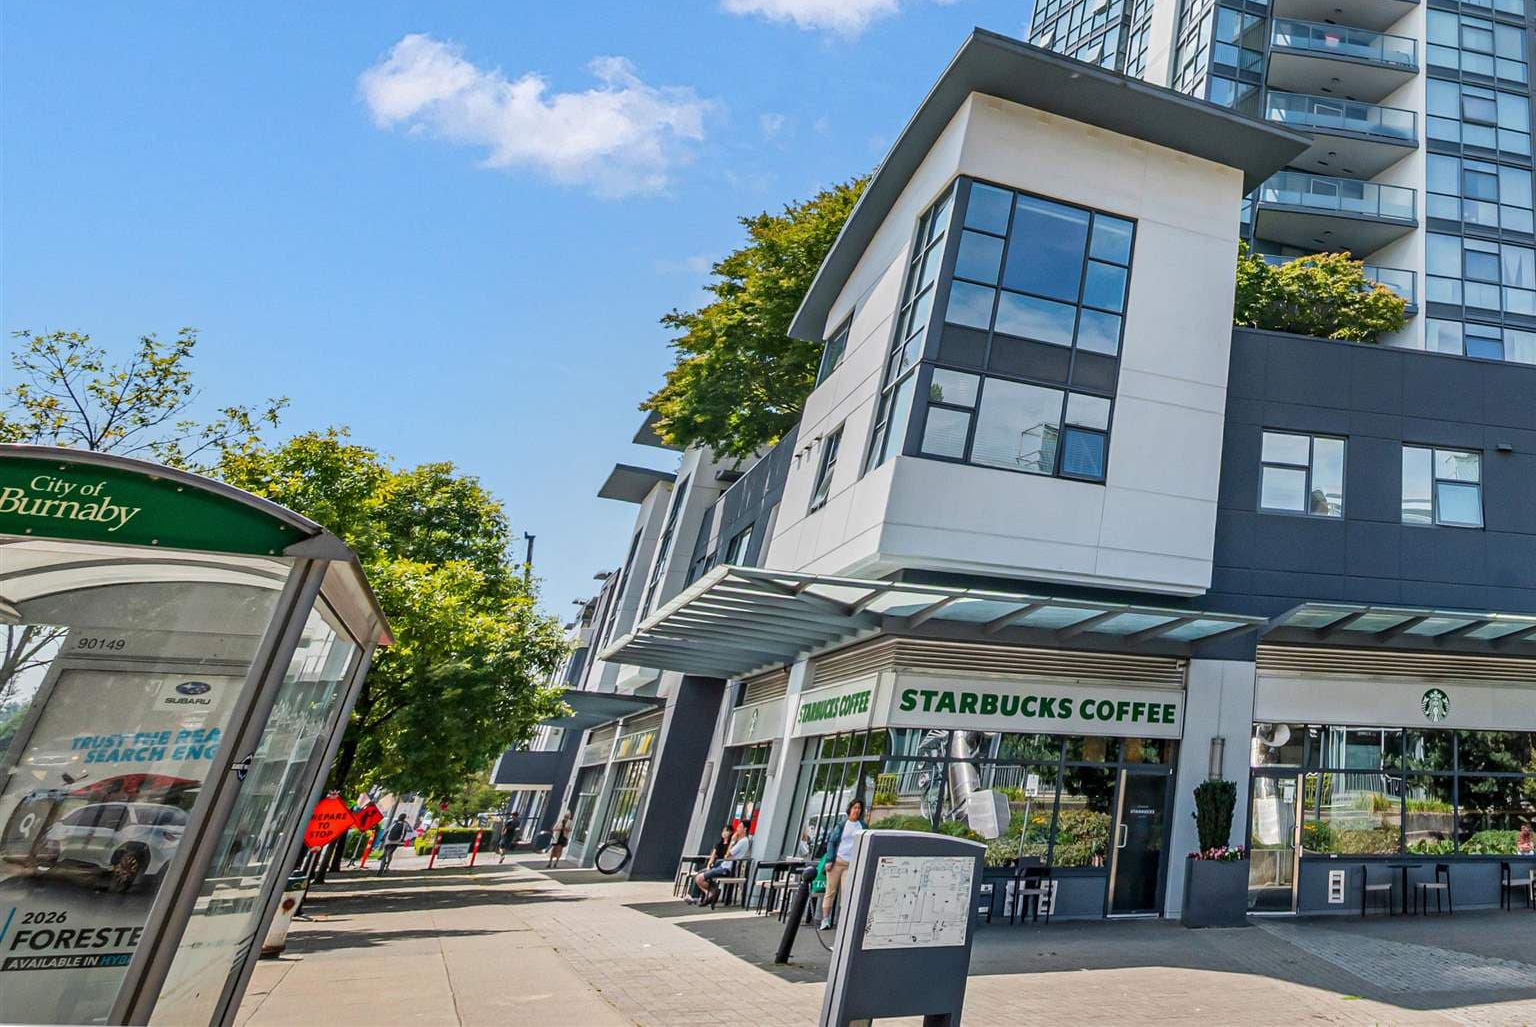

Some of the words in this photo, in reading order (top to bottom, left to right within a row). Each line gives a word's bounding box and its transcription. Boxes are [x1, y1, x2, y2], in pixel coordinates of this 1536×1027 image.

[30, 475, 78, 498] City
[79, 481, 108, 496] of
[0, 486, 142, 532] Burnaby
[77, 638, 126, 651] 90149
[164, 697, 212, 705] SUBARU
[798, 697, 840, 723] STARBUCKS
[839, 690, 872, 717] COFFEE
[898, 688, 1073, 720] STARBUCKS
[1078, 698, 1177, 724] COFFEE
[72, 734, 125, 750] TRUST
[132, 730, 173, 746] THE
[174, 727, 221, 744] REA
[84, 746, 167, 765] SEARCH
[21, 911, 67, 925] 2026
[9, 926, 144, 951] FORESTE
[7, 956, 82, 970] AVAILABLE
[83, 956, 100, 967] IN
